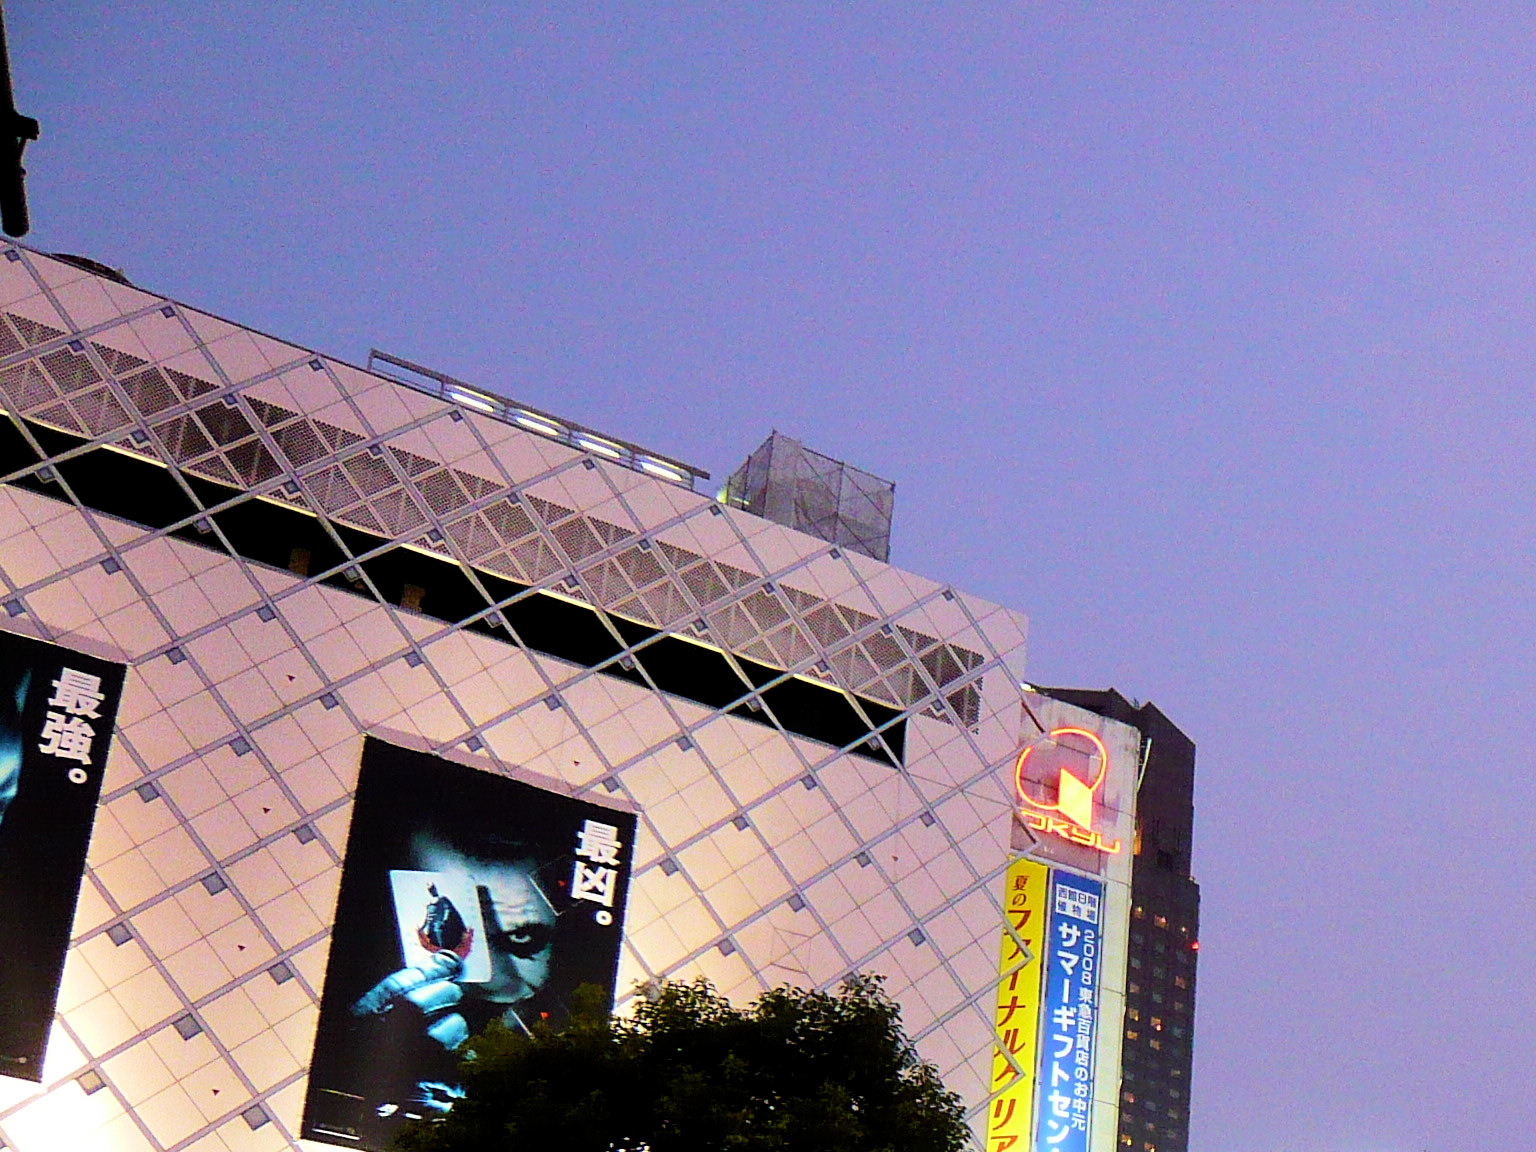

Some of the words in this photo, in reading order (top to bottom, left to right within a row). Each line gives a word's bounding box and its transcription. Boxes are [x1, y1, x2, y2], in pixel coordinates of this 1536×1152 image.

[40, 666, 104, 784] 最強。
[571, 819, 621, 926] 最凶。
[1081, 928, 1095, 985] 2008
[1070, 987, 1093, 1131] 東急百貨店のお中元
